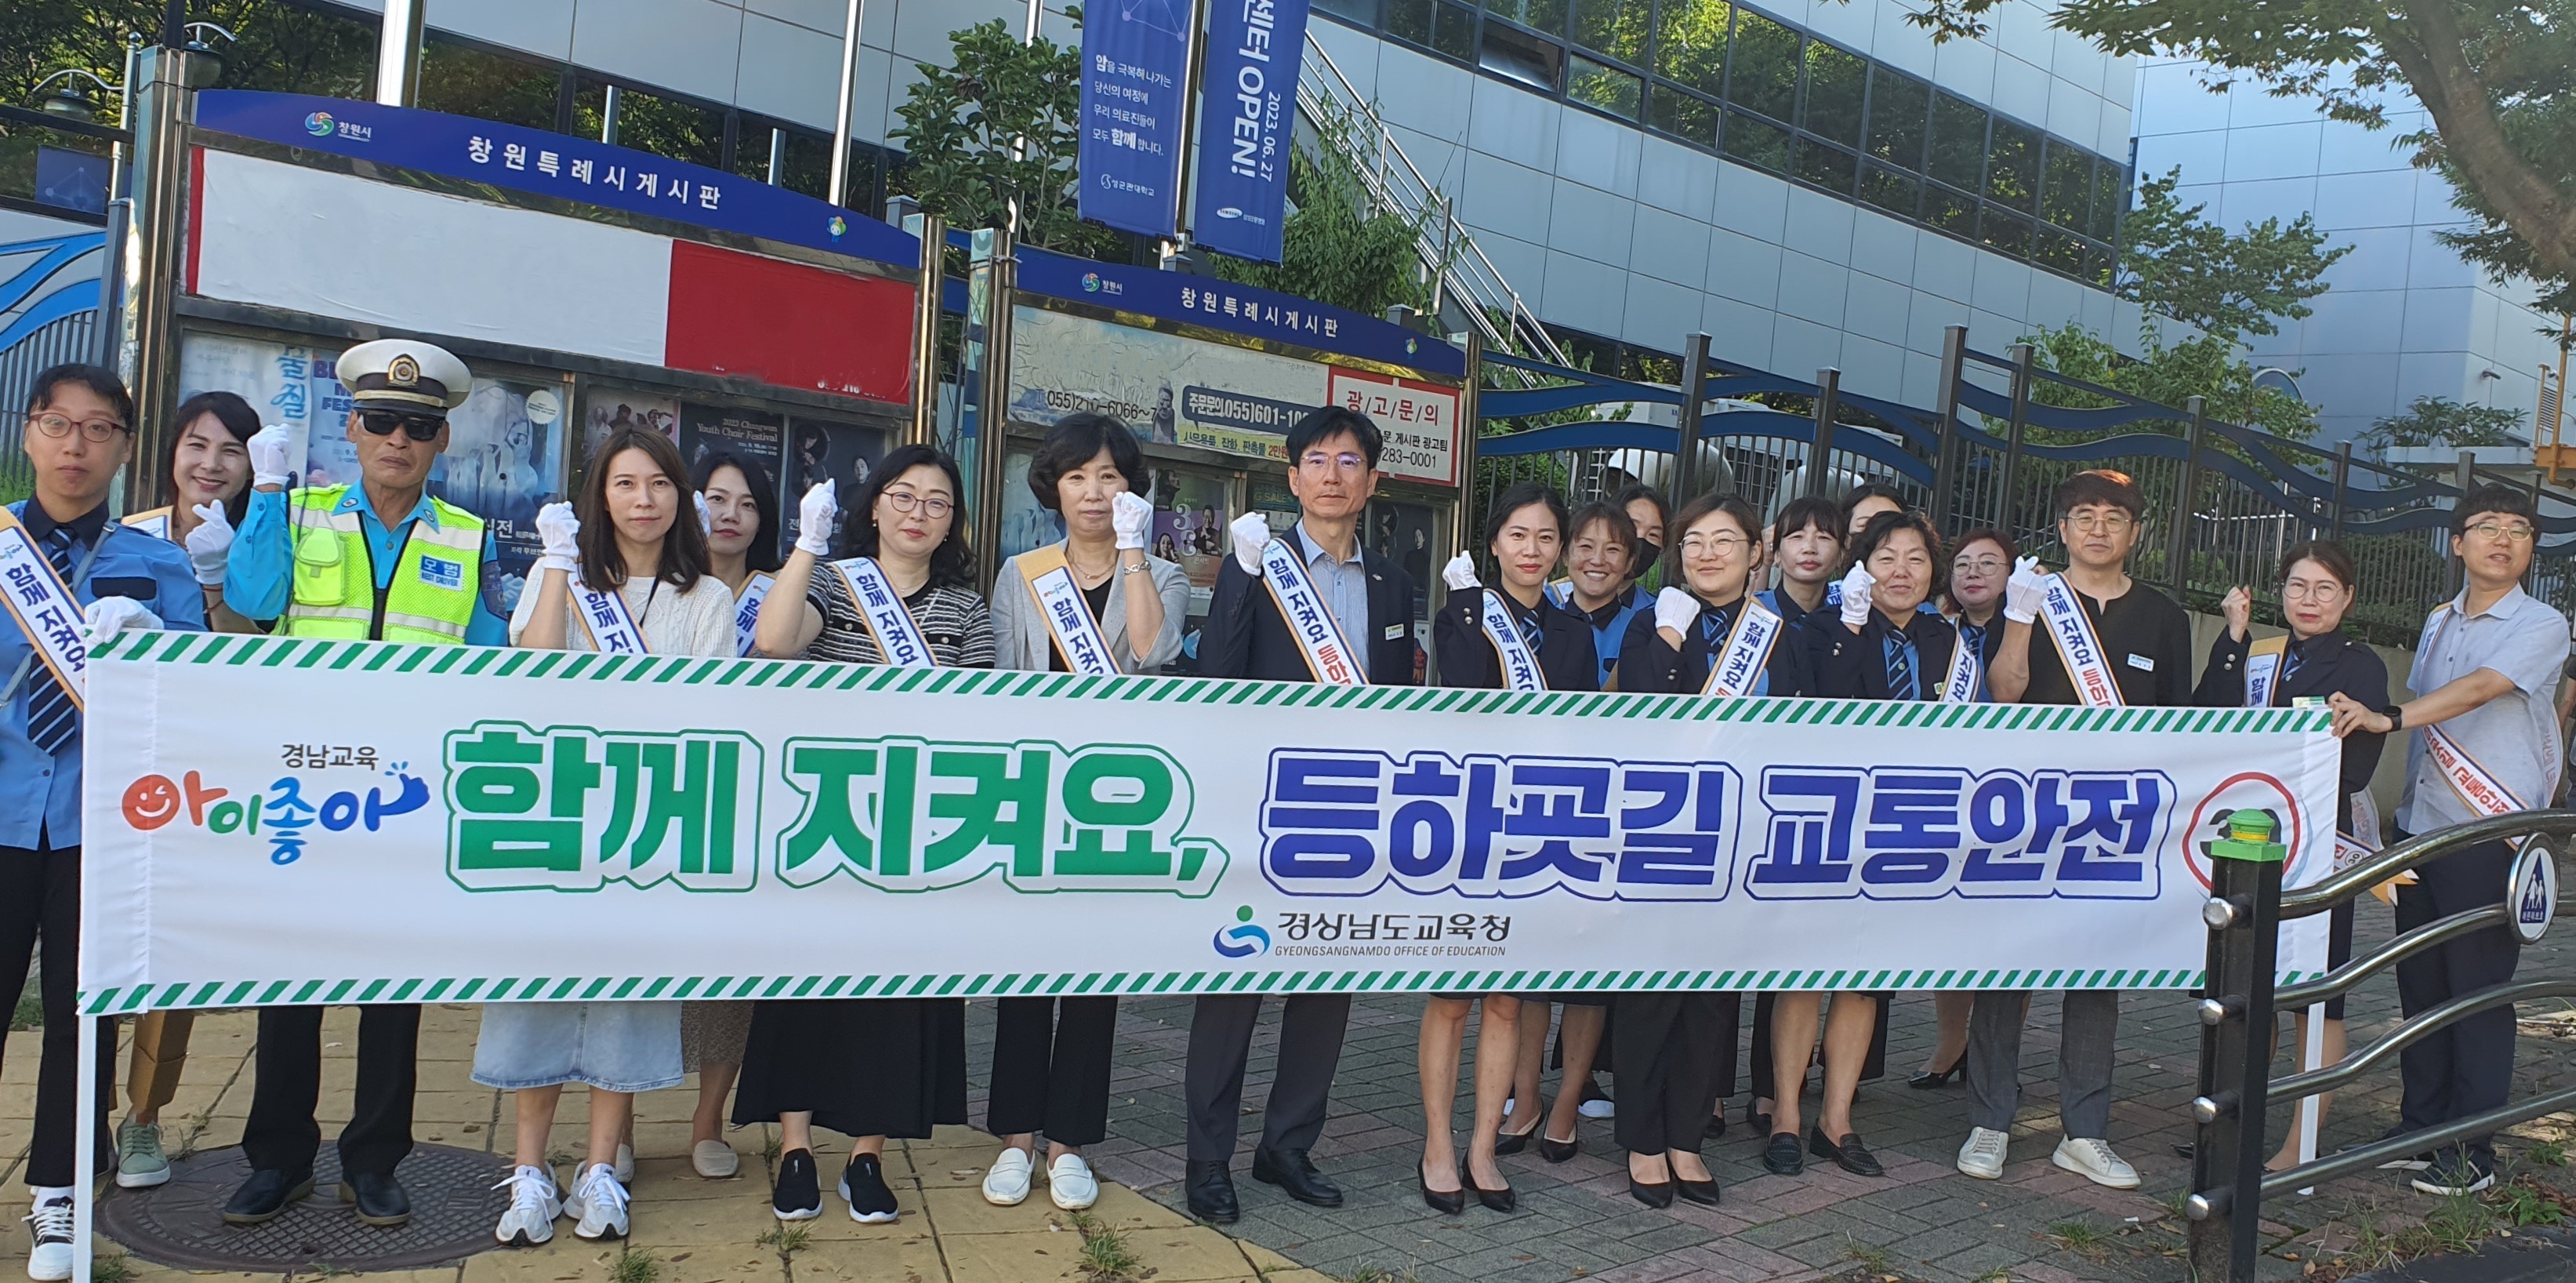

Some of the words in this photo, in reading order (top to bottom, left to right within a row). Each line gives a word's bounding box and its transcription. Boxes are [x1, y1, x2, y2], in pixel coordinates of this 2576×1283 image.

[1096, 54, 1116, 74] 암을
[1118, 63, 1145, 81] 극복해
[1146, 71, 1171, 88] 나가는
[1094, 81, 1120, 98] 당신의
[1123, 88, 1148, 105] 여정에
[1094, 104, 1110, 118] 우리
[1112, 108, 1156, 130] 의료진들이
[1232, 66, 1264, 179] OPEN!
[1265, 92, 1281, 133] 2023.
[339, 122, 372, 138] 창원시
[1093, 128, 1109, 142] 모두
[1111, 128, 1137, 150] 함께
[1263, 136, 1276, 158] 06.
[1261, 162, 1273, 183] 27
[1102, 280, 1123, 293] 창원시
[1188, 392, 1225, 418] 주문문의
[697, 423, 720, 435] Youth
[722, 427, 744, 439] Choir
[746, 430, 778, 442] Festival
[1395, 432, 1420, 448] 게시판
[1423, 437, 1448, 452] 광고팀
[1264, 491, 1286, 503] SALE
[584, 591, 620, 628] 함께
[1052, 597, 1082, 633] 함께
[1268, 557, 1299, 590] 함께
[1288, 591, 1328, 644] 지켜요
[6, 563, 51, 607] 함께
[35, 605, 85, 672] 지켜요
[856, 573, 890, 607] 함께
[876, 609, 919, 666] 지켜요
[1486, 612, 1516, 643] 함께
[1741, 621, 1765, 649] 함께
[2059, 616, 2094, 666] 지켜요
[1722, 645, 1754, 689] 지켜요
[1952, 652, 1972, 702] 지켜요
[2251, 676, 2266, 706] 함께
[281, 743, 379, 770] 경남교육
[122, 769, 430, 866] 아이좋아
[455, 732, 740, 874] 함께
[786, 745, 1209, 881] 지켜요,
[1268, 757, 1725, 886] 등하굣길
[1751, 773, 2159, 885] 교통안전
[1277, 913, 1511, 942] 경상남도교육청
[1275, 945, 1391, 957] GYEONGSANGNAMDO
[1393, 945, 1428, 957] OFFICE
[1431, 946, 1445, 957] OF
[1446, 946, 1507, 958] EDUCATION
